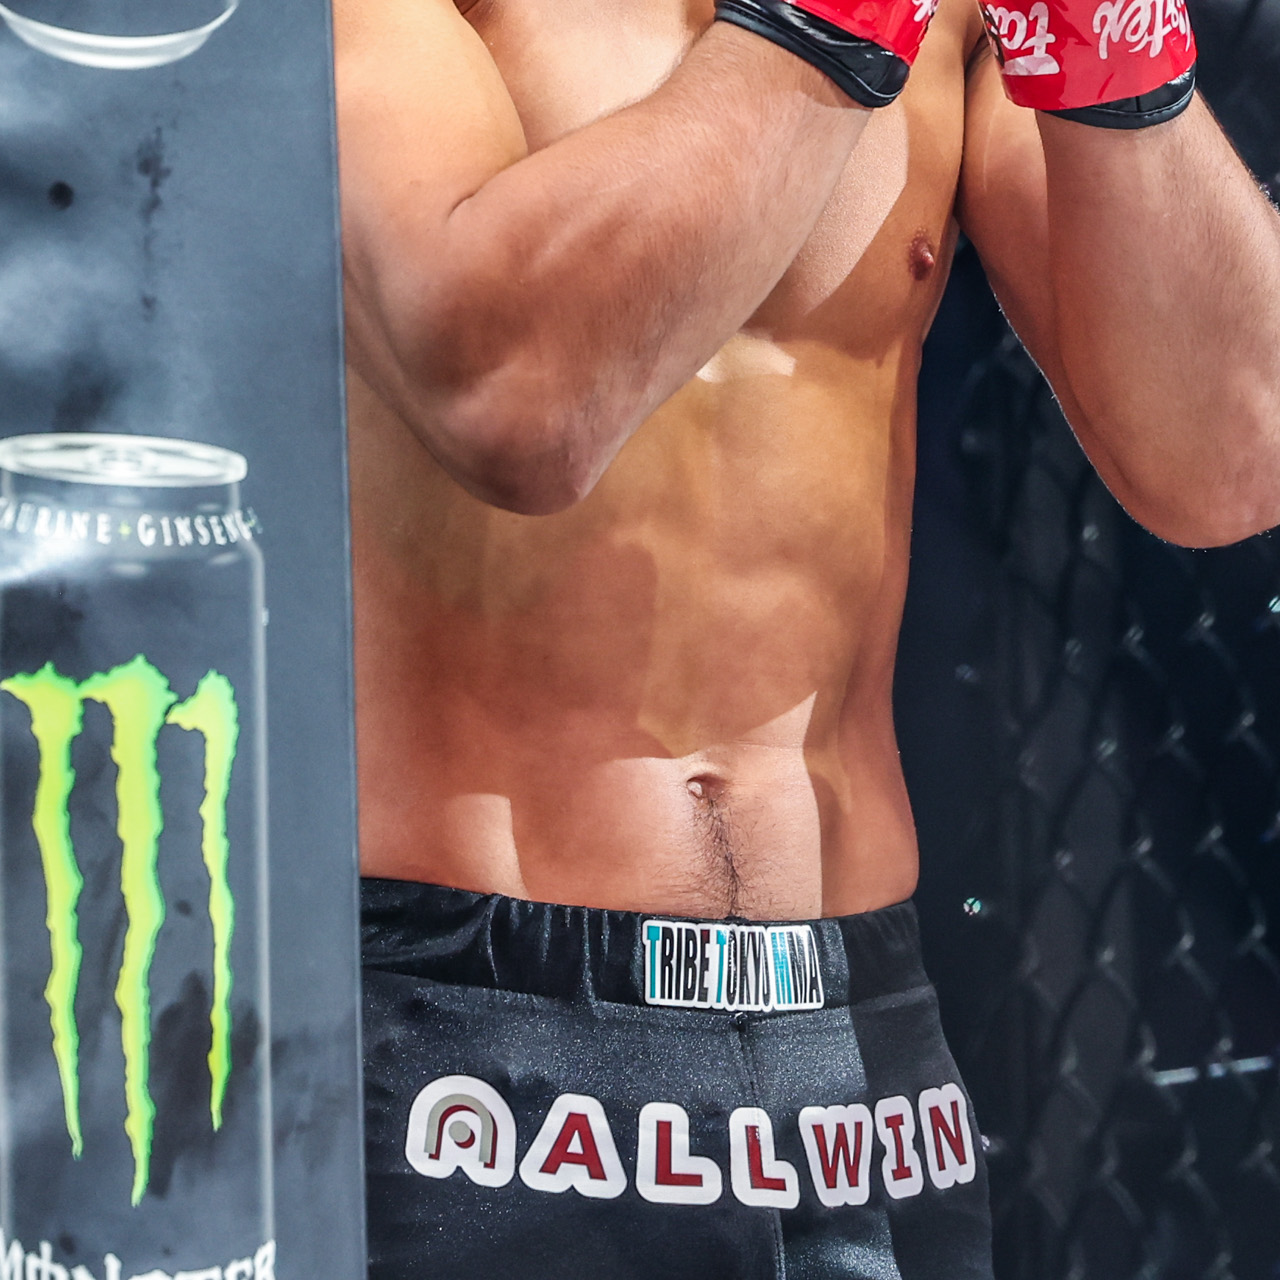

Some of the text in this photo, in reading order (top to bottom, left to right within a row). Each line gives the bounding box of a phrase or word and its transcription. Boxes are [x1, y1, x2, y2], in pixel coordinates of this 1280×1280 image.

[646, 925, 711, 1003] TRIBE
[716, 929, 772, 1007] TOKYO
[536, 1098, 969, 1194] ALLWIN
